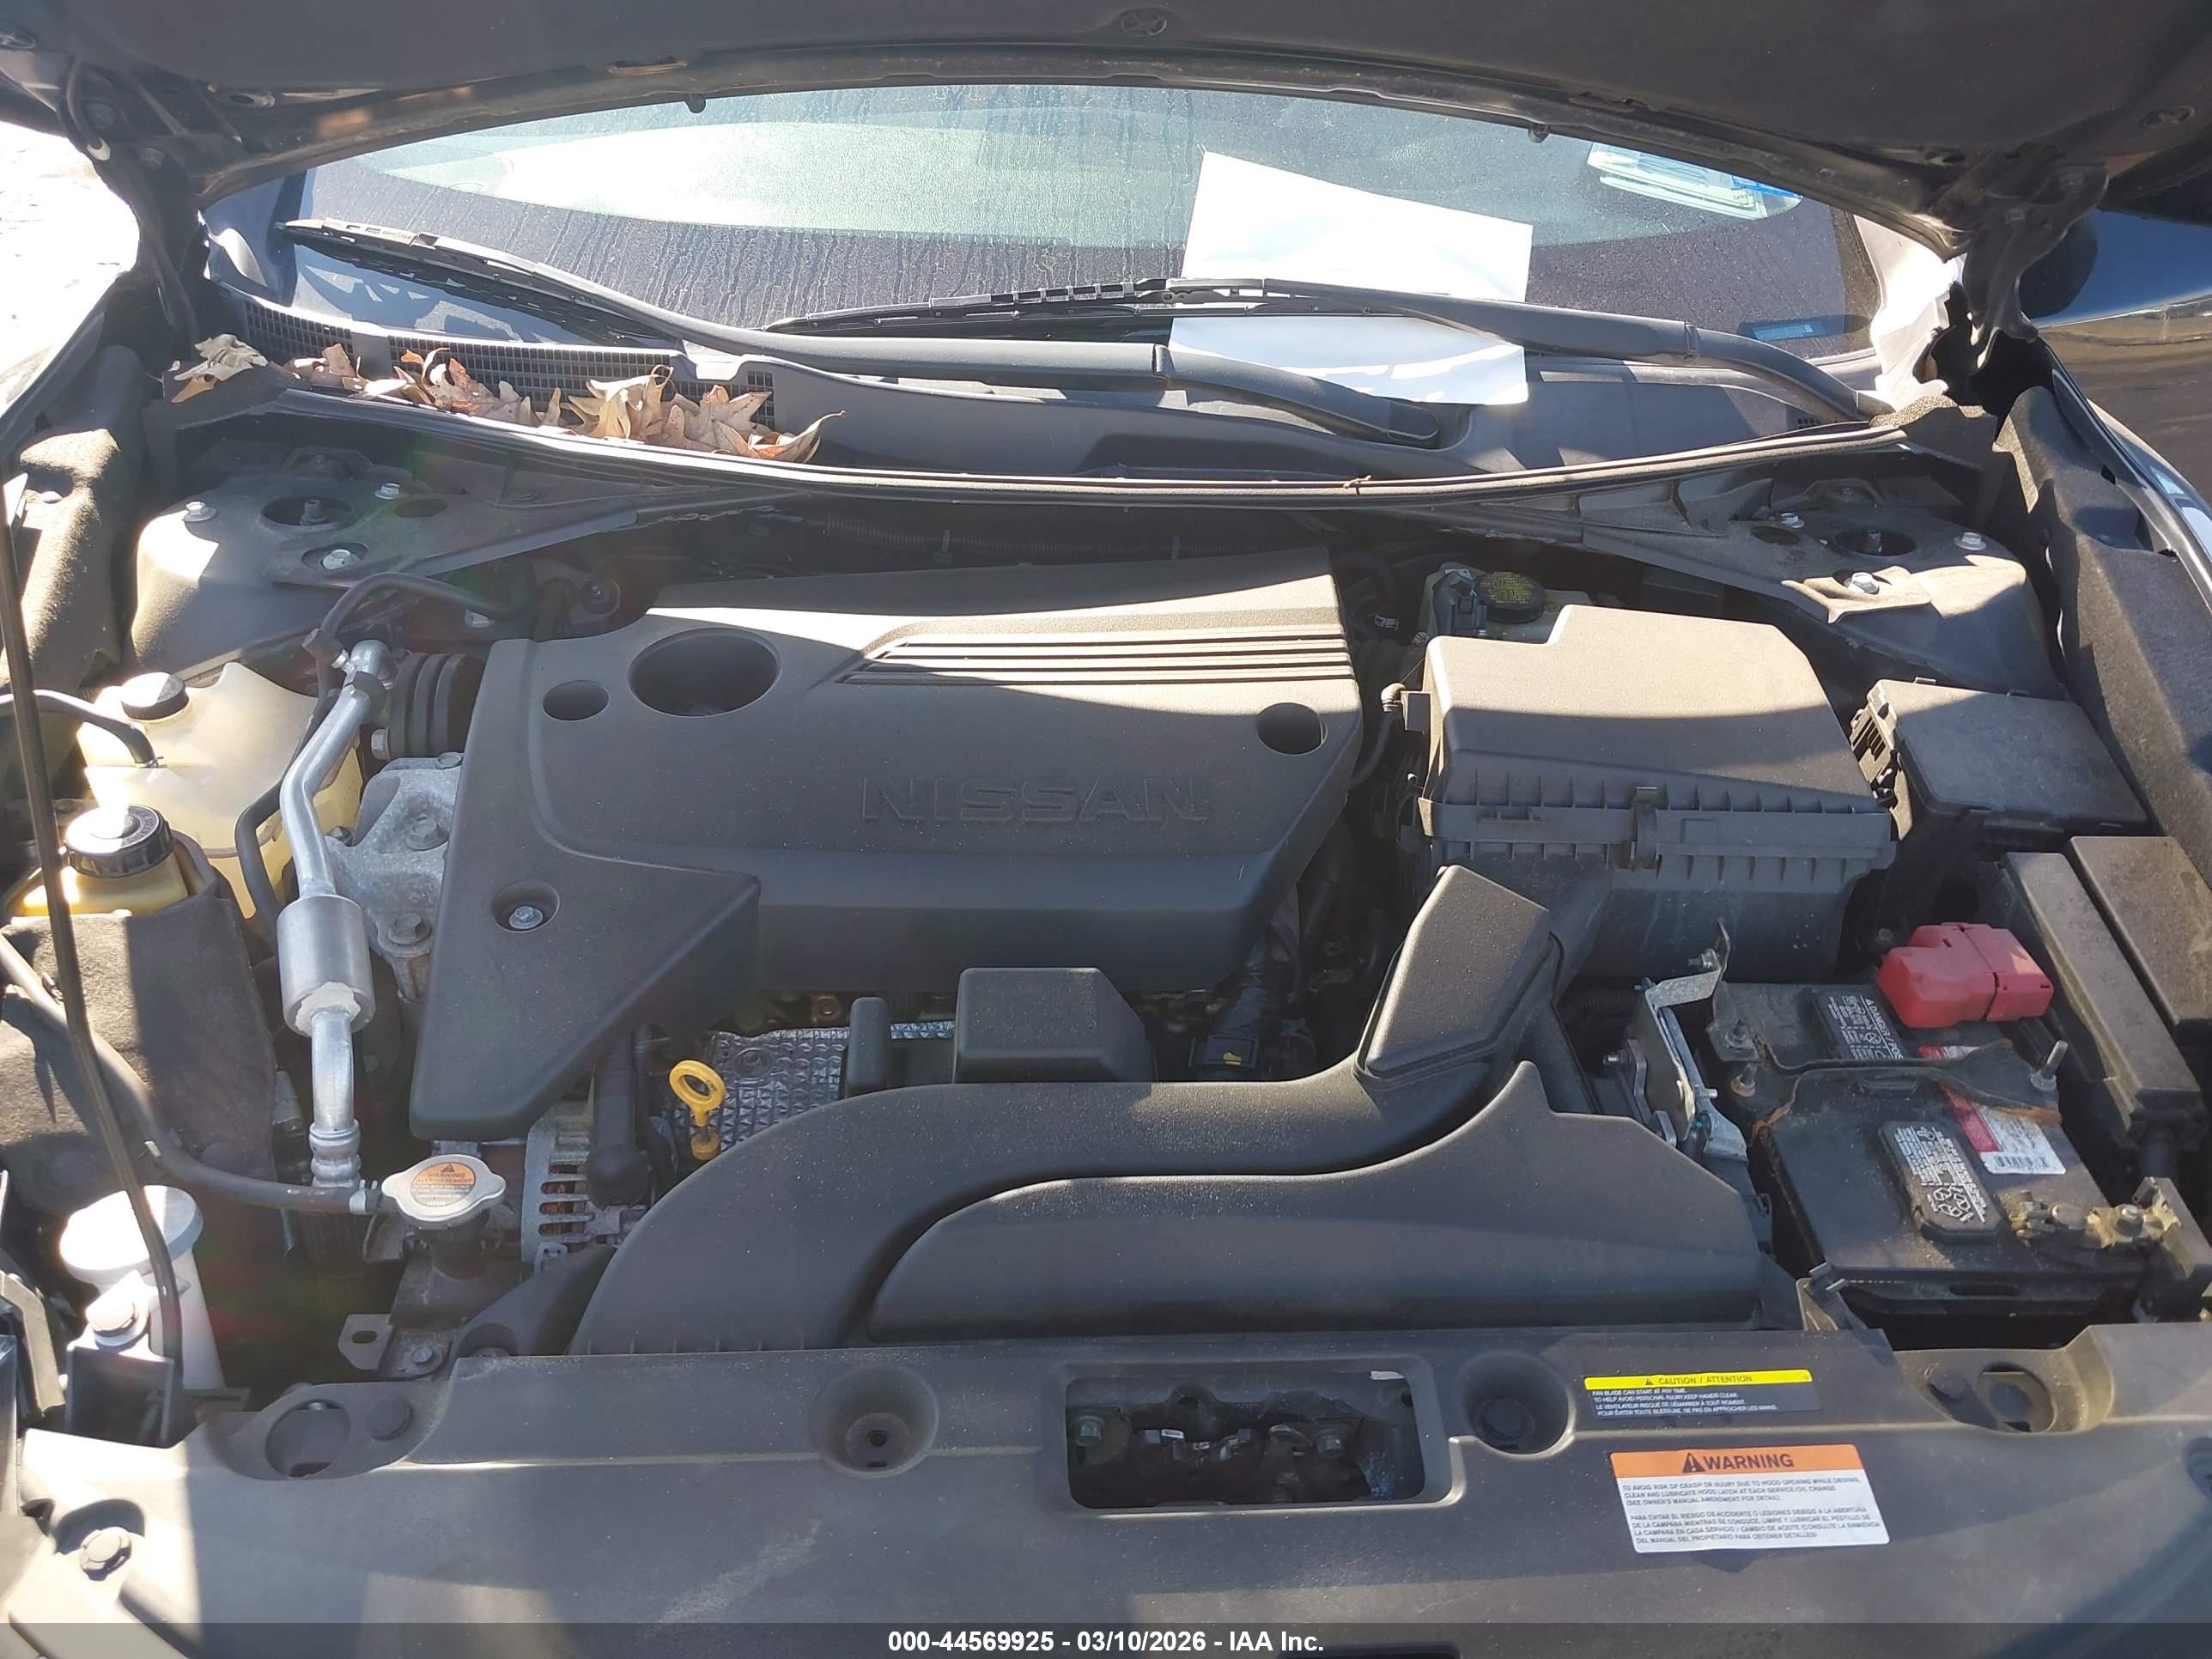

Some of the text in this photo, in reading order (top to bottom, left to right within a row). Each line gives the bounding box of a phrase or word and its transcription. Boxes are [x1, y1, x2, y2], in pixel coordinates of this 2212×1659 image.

[860, 775, 1209, 822] NISSAN
[1869, 1006, 1891, 1036] DANGER
[1706, 1375, 1753, 1383] ATTENTION
[1704, 1453, 1794, 1470] WARNING
